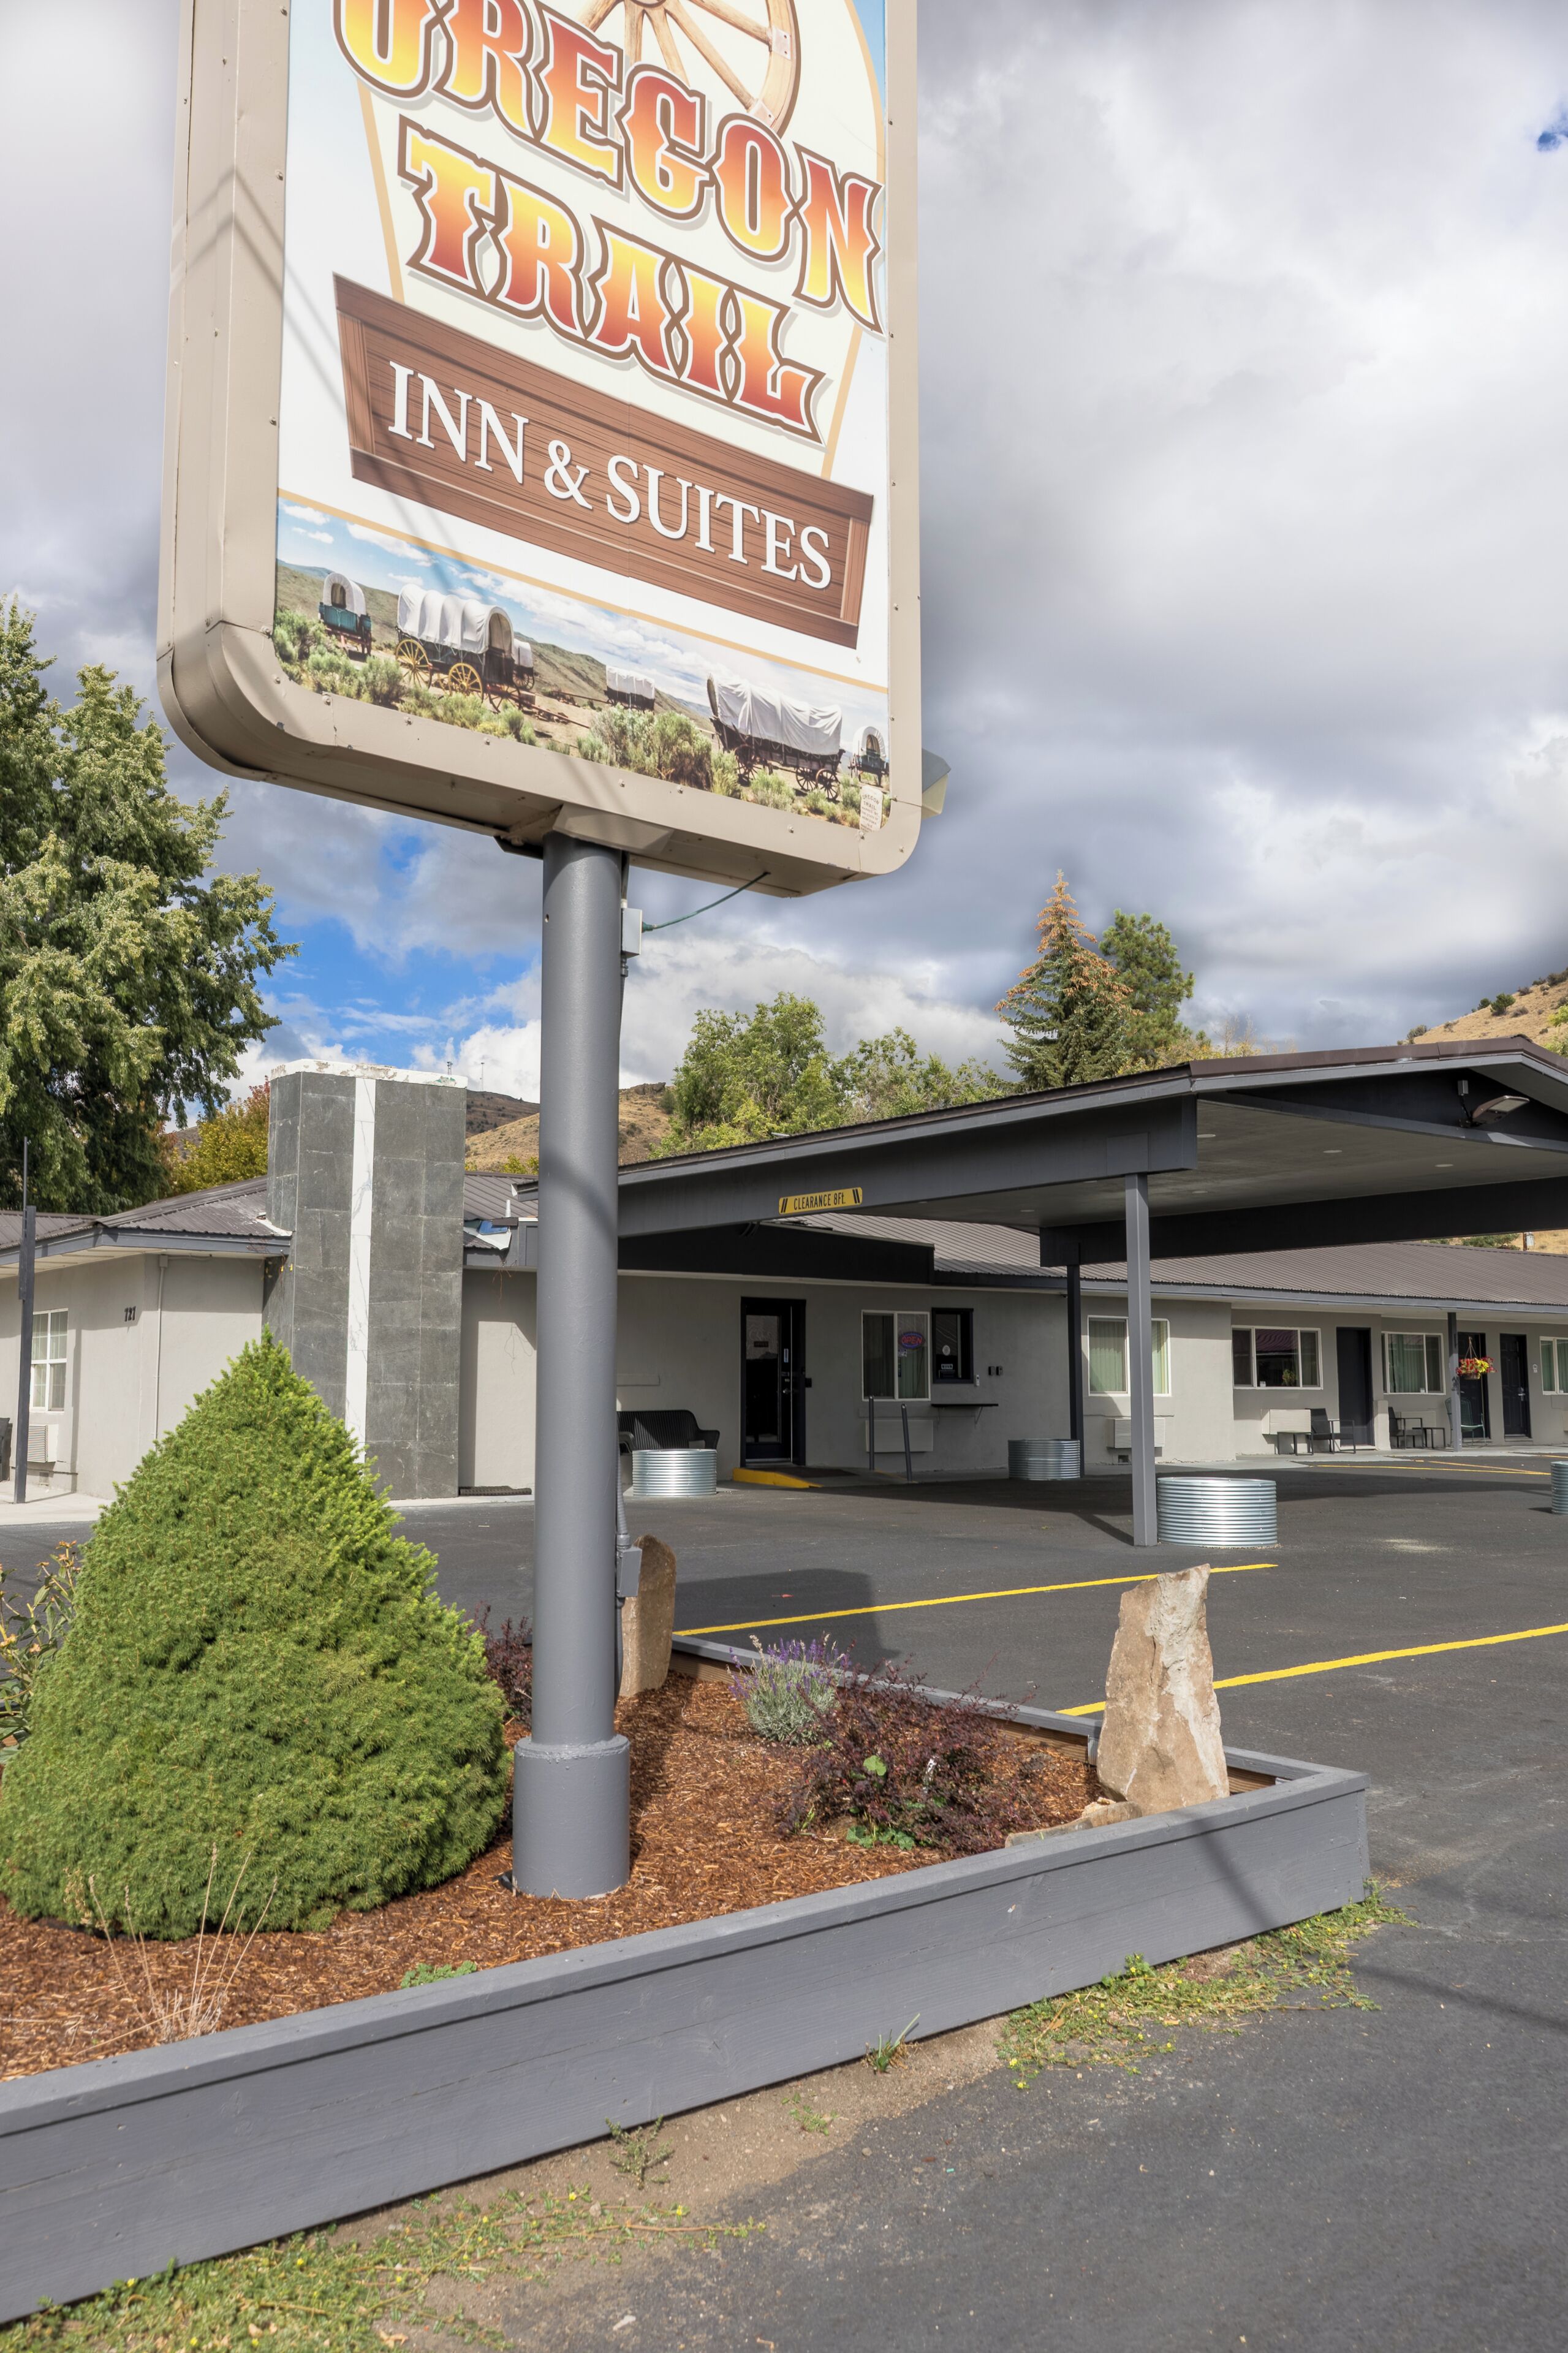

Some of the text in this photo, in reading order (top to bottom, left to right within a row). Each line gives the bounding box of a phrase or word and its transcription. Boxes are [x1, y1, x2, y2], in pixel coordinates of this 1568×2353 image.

[399, 116, 826, 444] TRAIL
[388, 360, 831, 589] INN & SUITES
[862, 794, 880, 805] OREGON
[863, 800, 876, 810] TRAIL
[793, 1194, 831, 1210] CLEARANCE
[124, 1306, 136, 1322] 727
[901, 1336, 922, 1344] OPEN
